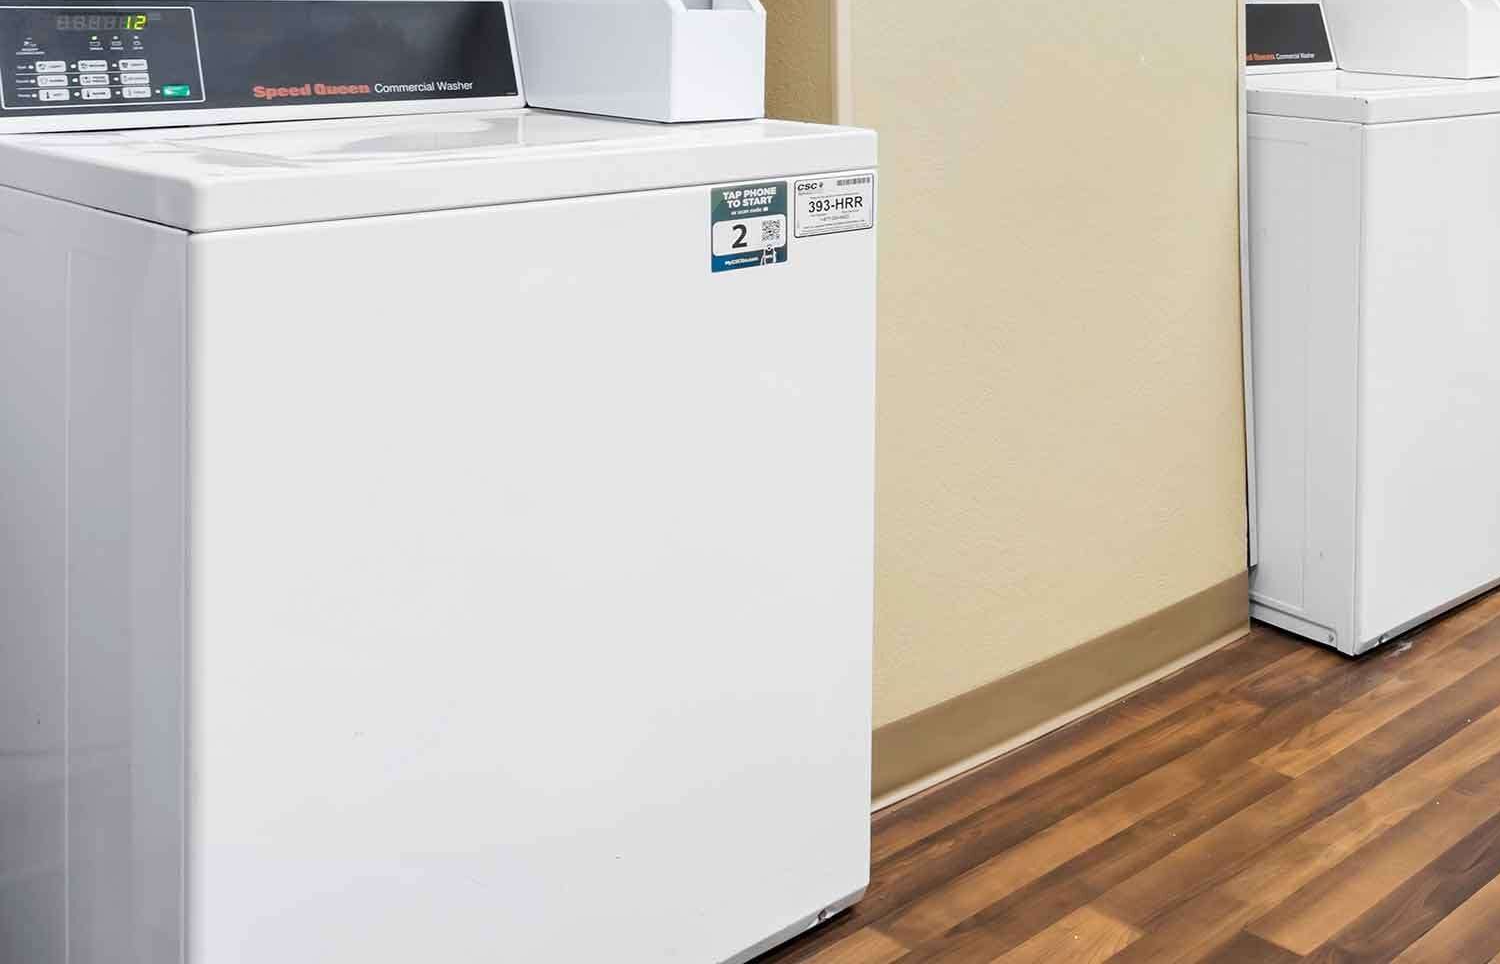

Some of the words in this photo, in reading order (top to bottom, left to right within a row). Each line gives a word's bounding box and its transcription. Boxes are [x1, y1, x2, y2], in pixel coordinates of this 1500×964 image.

[125, 15, 147, 31] 12
[253, 84, 311, 101] Speed
[314, 83, 371, 96] Queen
[374, 81, 435, 93] Commercial
[436, 80, 473, 91] Washer
[723, 190, 743, 202] TAP
[743, 186, 776, 199] PHONE
[797, 182, 818, 192] CSC
[727, 198, 742, 209] TO
[742, 195, 773, 207] START
[808, 195, 863, 214] 393-HRR
[731, 224, 748, 249] 2
